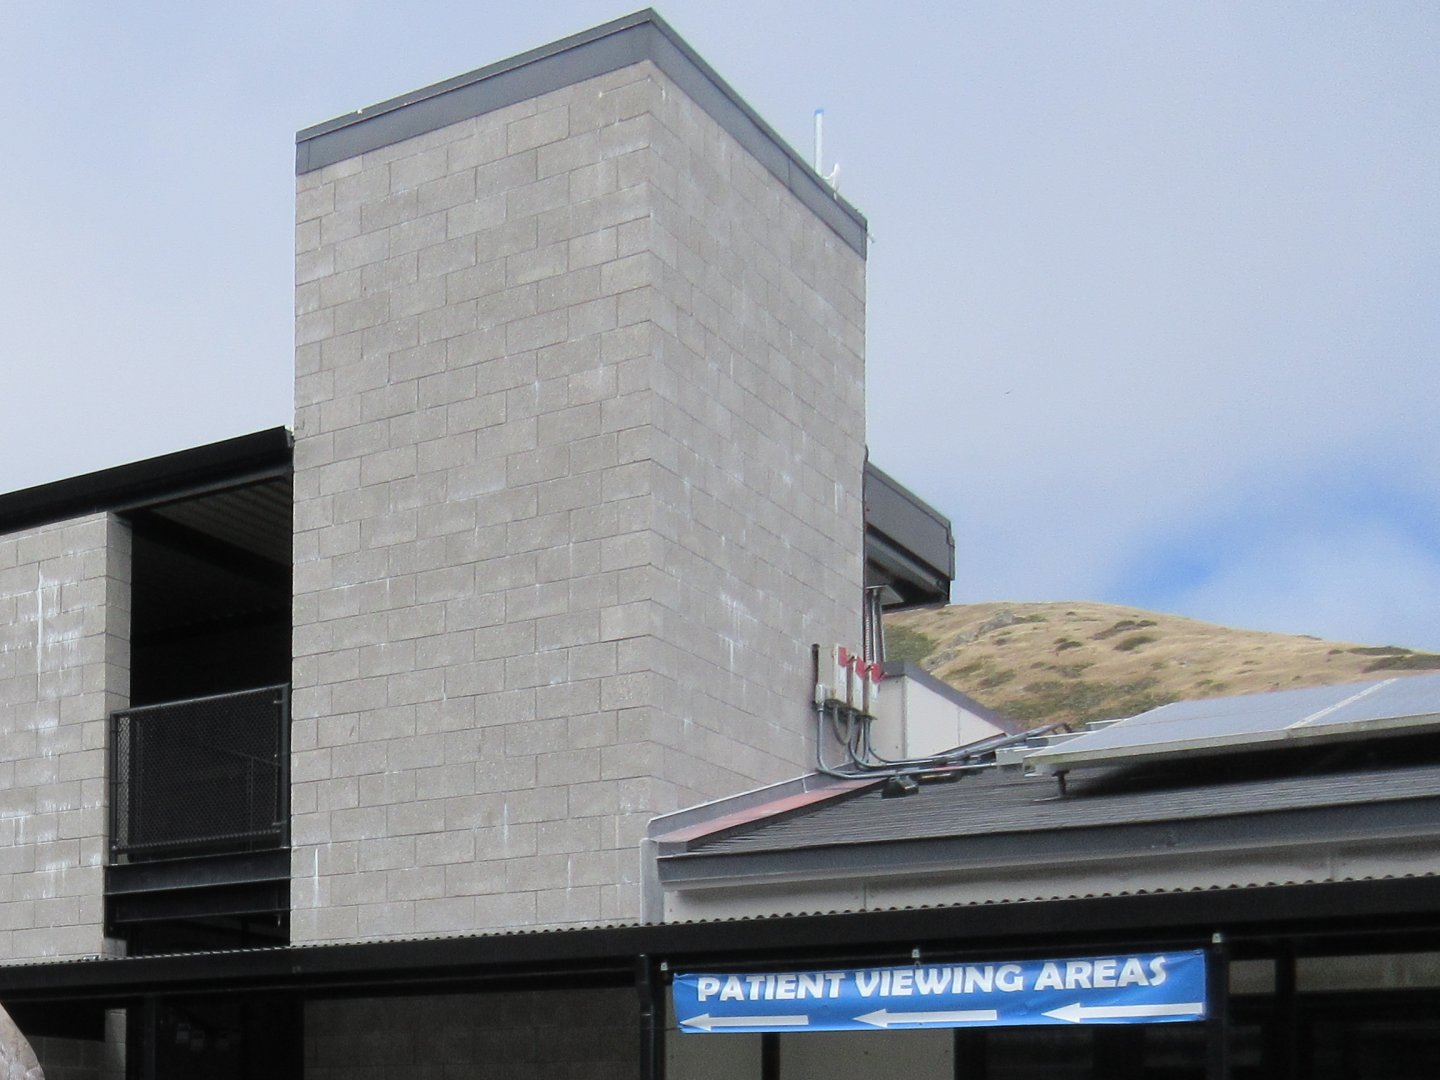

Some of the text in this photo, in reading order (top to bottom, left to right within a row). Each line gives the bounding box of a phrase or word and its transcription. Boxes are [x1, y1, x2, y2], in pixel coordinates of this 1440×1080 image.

[697, 956, 1167, 1002] PATIENT VIEWING AREAS
